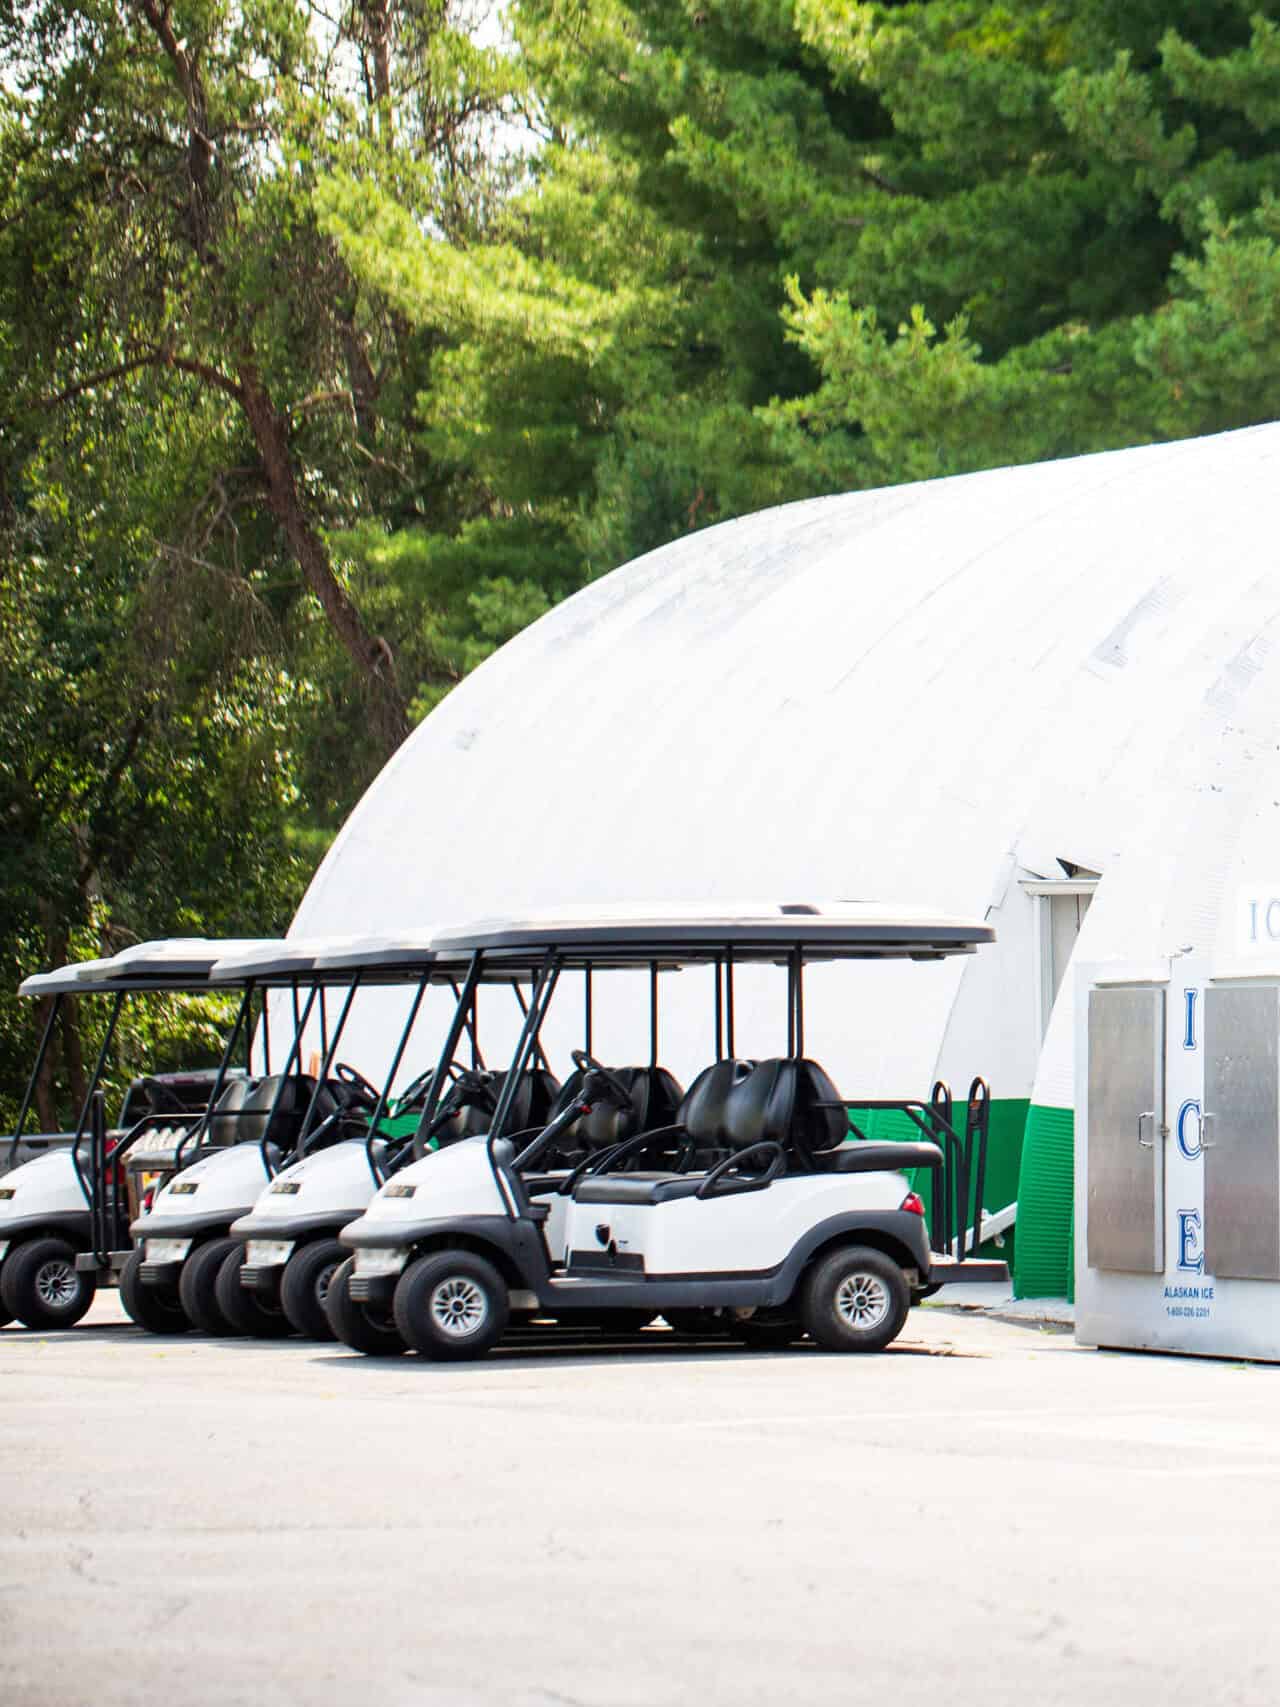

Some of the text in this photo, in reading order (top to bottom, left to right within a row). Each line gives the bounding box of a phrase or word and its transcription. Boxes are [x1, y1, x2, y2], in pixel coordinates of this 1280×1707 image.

[1176, 988, 1204, 1275] ICE
[1164, 1286, 1214, 1299] ALASKAN ICE
